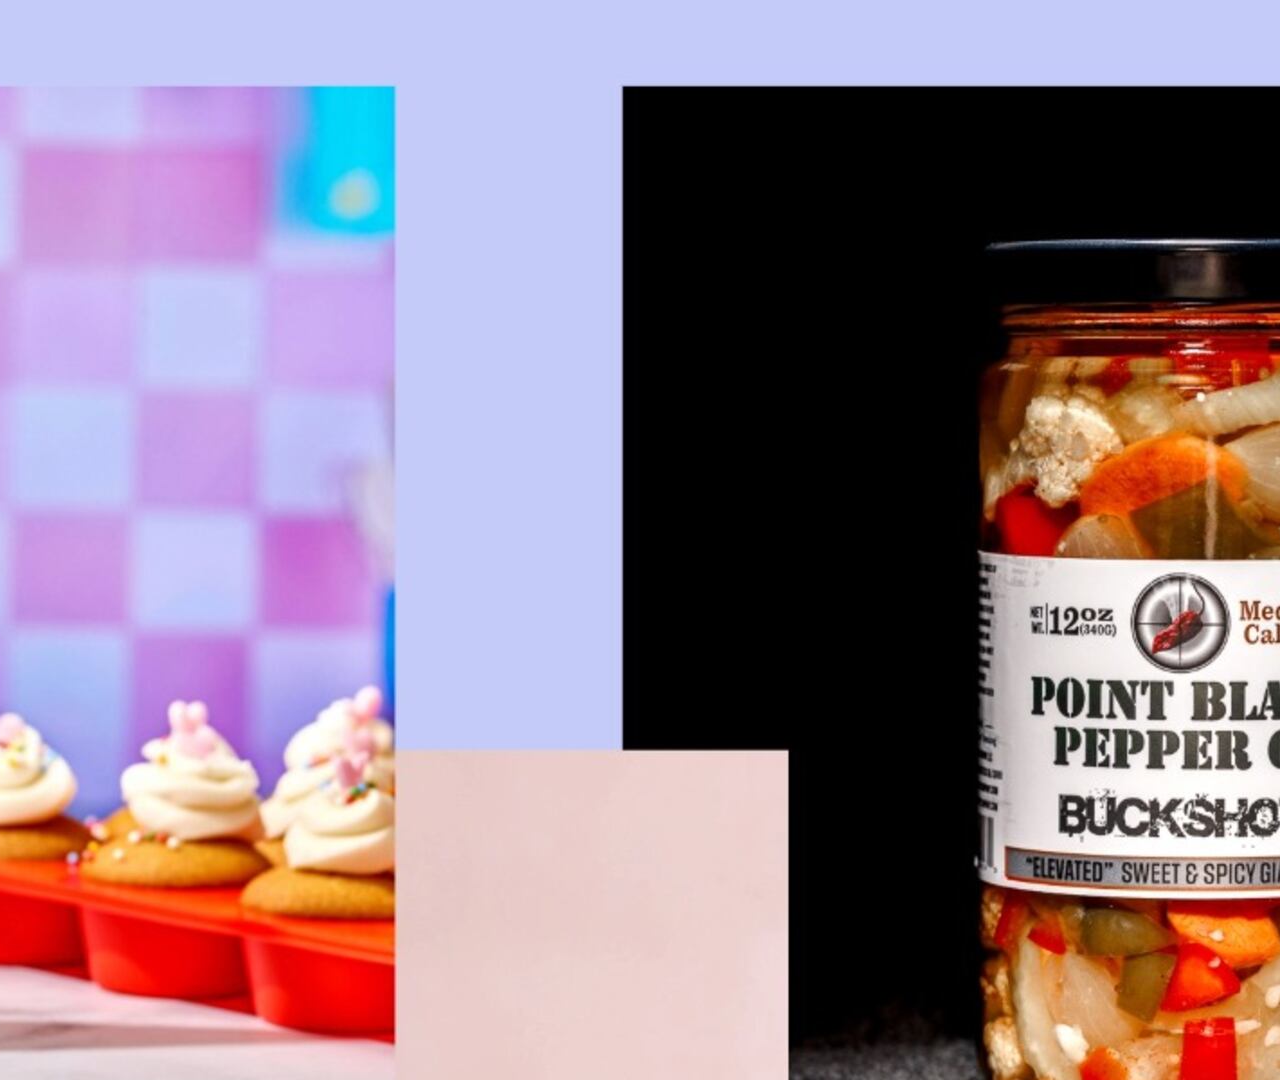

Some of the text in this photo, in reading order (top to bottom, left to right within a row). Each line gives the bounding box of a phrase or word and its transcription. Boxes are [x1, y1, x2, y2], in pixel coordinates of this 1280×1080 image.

[1029, 606, 1044, 619] NET
[1031, 676, 1174, 721] POINT
[1053, 726, 1253, 771] PEPPER
[1122, 862, 1180, 885] SWEET
[1186, 863, 1199, 885] &
[1203, 861, 1256, 885] SPICY
